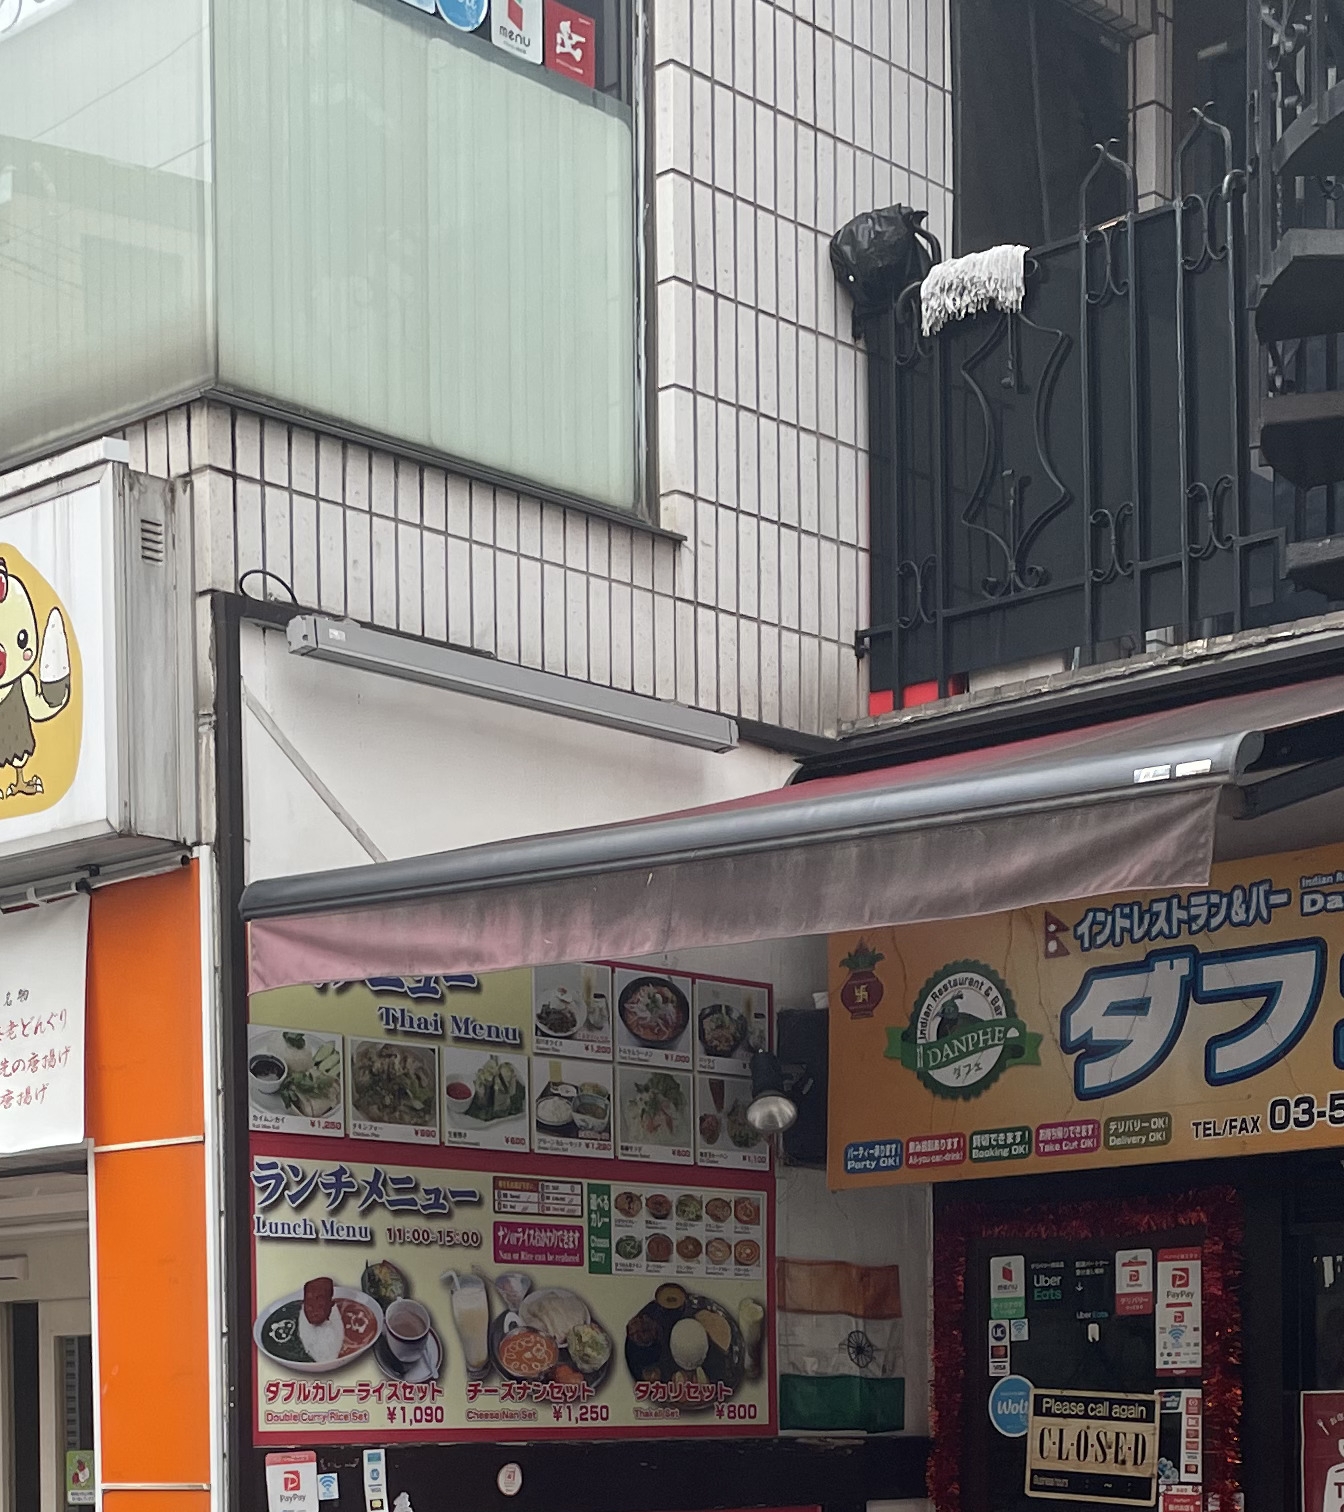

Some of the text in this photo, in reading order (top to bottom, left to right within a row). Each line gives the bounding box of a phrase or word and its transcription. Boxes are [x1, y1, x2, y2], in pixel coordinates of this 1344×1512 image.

[499, 25, 531, 48] menu
[1075, 880, 1291, 949] インドレストラン&バー
[918, 1004, 933, 1040] Indian
[931, 976, 984, 1003] Restaurant
[991, 995, 1003, 1016] Bar
[378, 1006, 520, 1044] Thai Menu
[927, 1026, 1005, 1067] DANPHE
[1192, 1114, 1261, 1141] TEL/FAX
[1039, 1140, 1060, 1153] Take
[1109, 1134, 1147, 1147] Delivery
[972, 1147, 1009, 1159] Booking
[847, 1159, 876, 1172] Party
[250, 1160, 479, 1214] ランチメニュー
[254, 1215, 481, 1246] Lunch Menu 11:00-15:00
[1033, 1275, 1062, 1287] Uber
[1034, 1288, 1062, 1301] Eats
[1166, 1290, 1195, 1299] PayPay
[265, 1381, 444, 1403] ダブルカレーライスセット
[466, 1381, 595, 1403] チーズナンセット
[634, 1380, 733, 1403] タカリセット
[265, 1410, 299, 1424] Double
[329, 1410, 350, 1423] Rice
[351, 1409, 369, 1422] Set
[386, 1405, 444, 1426] ¥1,090
[502, 1409, 519, 1421] Nan
[520, 1409, 537, 1420] Set
[552, 1405, 609, 1424] ¥1,250
[715, 1404, 757, 1420] ¥800
[1042, 1398, 1146, 1419] Please call again
[280, 1493, 306, 1503] PayPay
